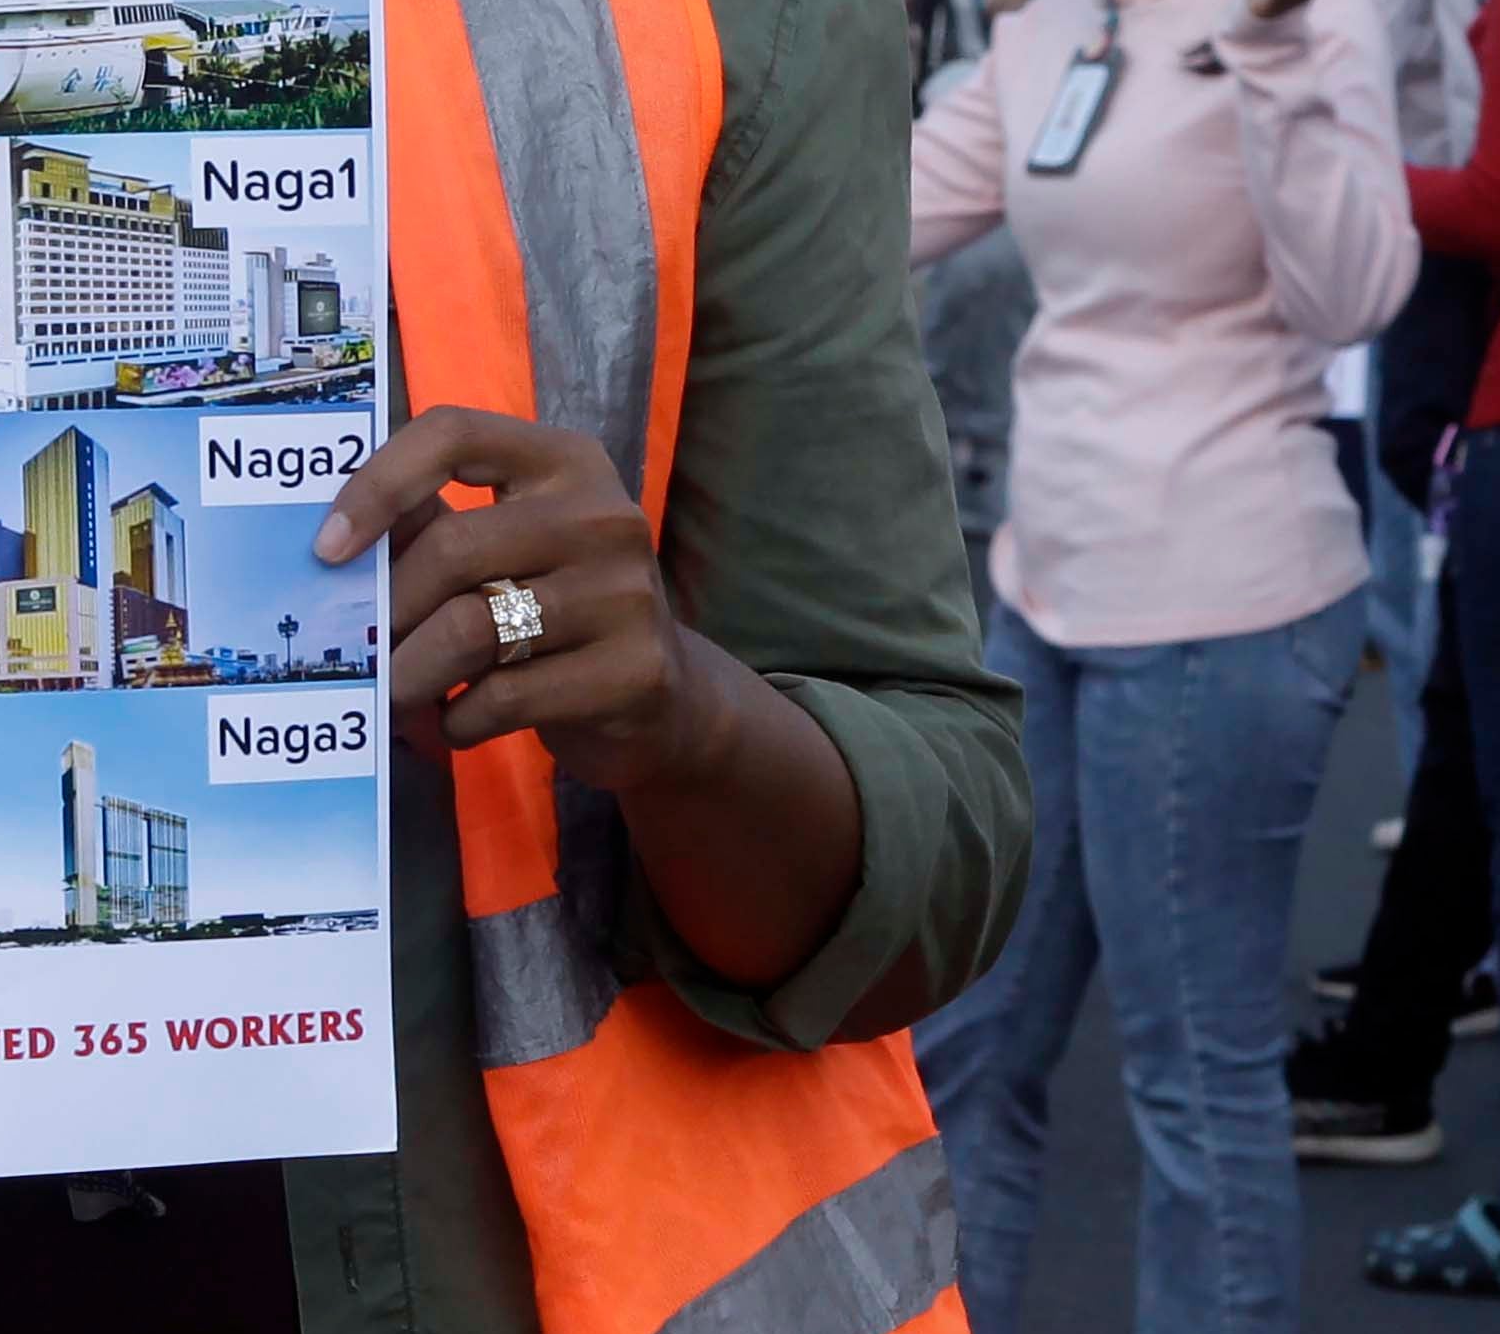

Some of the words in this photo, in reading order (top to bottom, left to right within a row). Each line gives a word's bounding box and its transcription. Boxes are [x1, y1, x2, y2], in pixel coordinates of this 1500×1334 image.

[203, 157, 356, 212] Naga1
[208, 434, 366, 489] Naga2
[219, 710, 367, 765] Naga3
[73, 1021, 148, 1057] 365
[165, 1008, 364, 1052] WORKERS
